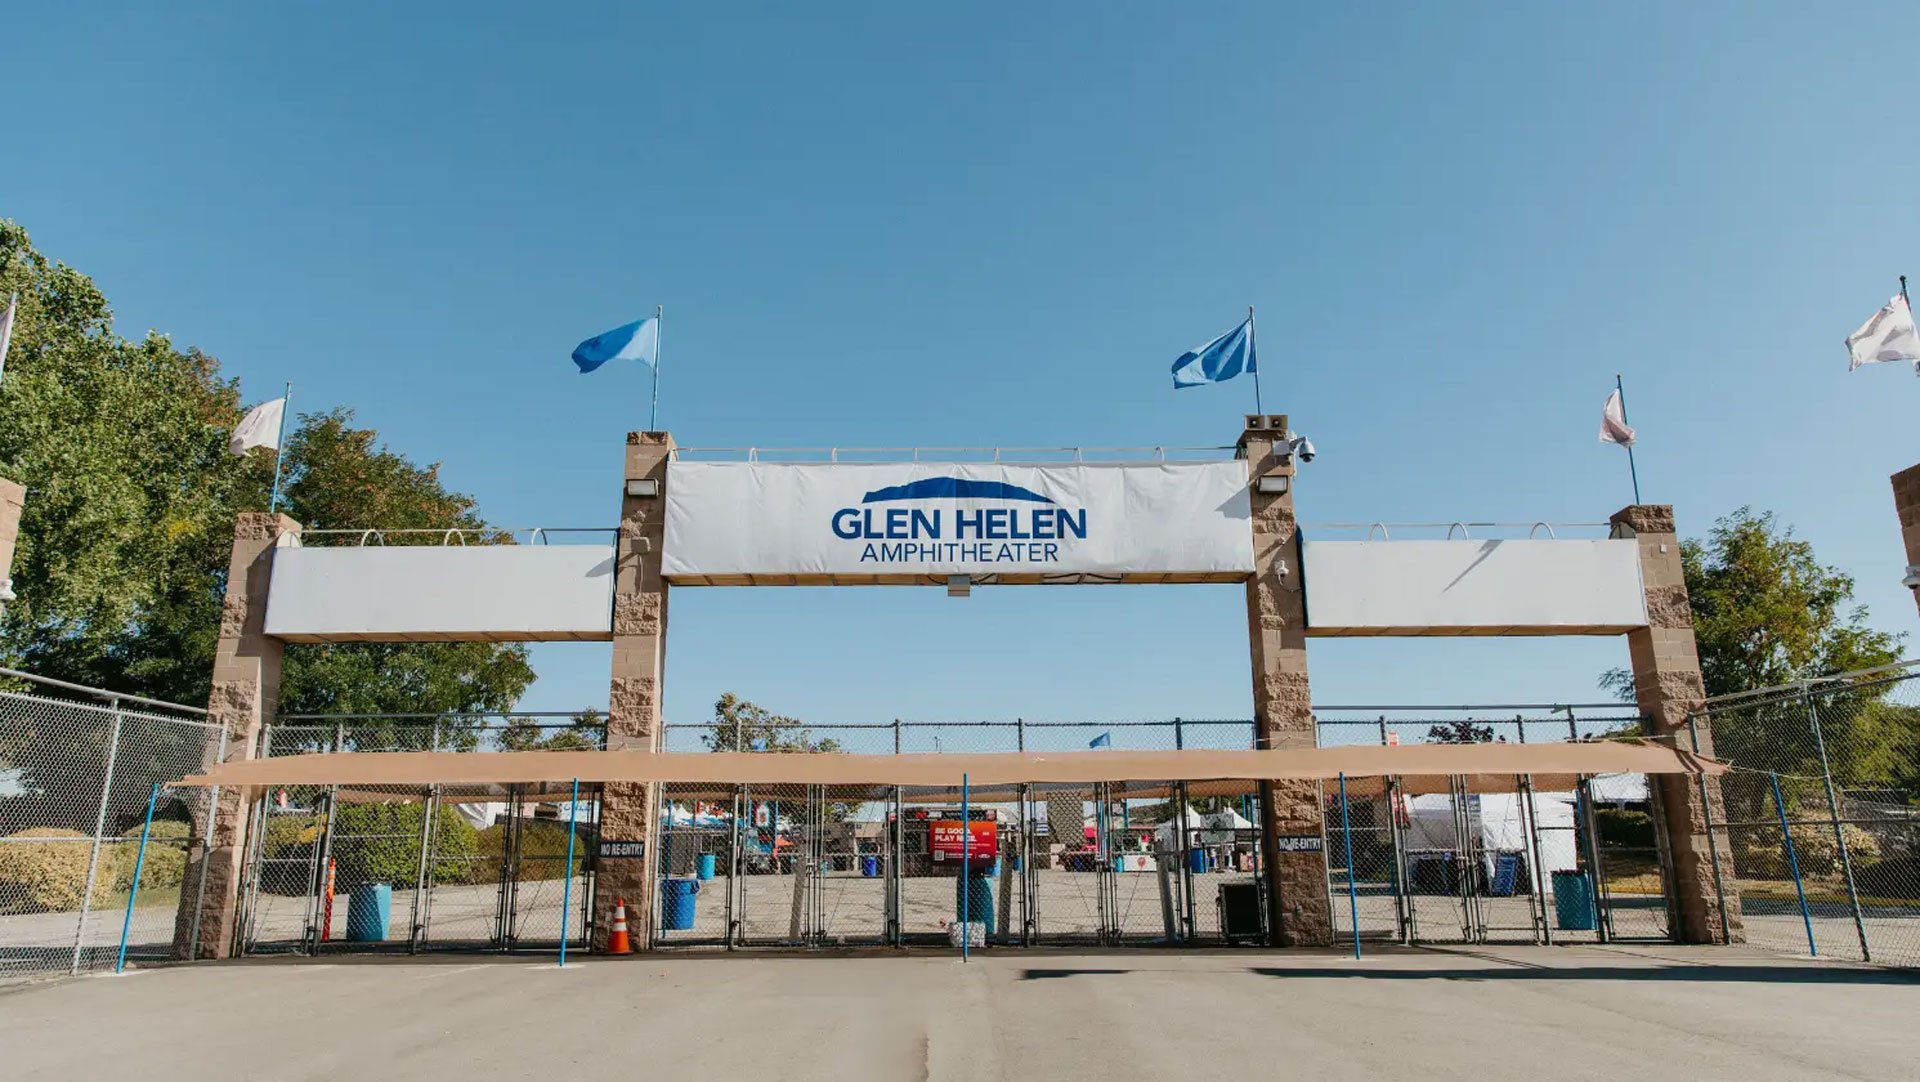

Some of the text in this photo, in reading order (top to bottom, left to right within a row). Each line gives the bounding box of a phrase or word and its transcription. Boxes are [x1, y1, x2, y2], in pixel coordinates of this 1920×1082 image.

[832, 508, 1087, 539] GLEN HELEN
[860, 543, 1059, 562] AMPHITHEATER
[600, 843, 644, 855] NO RE-ENTRY
